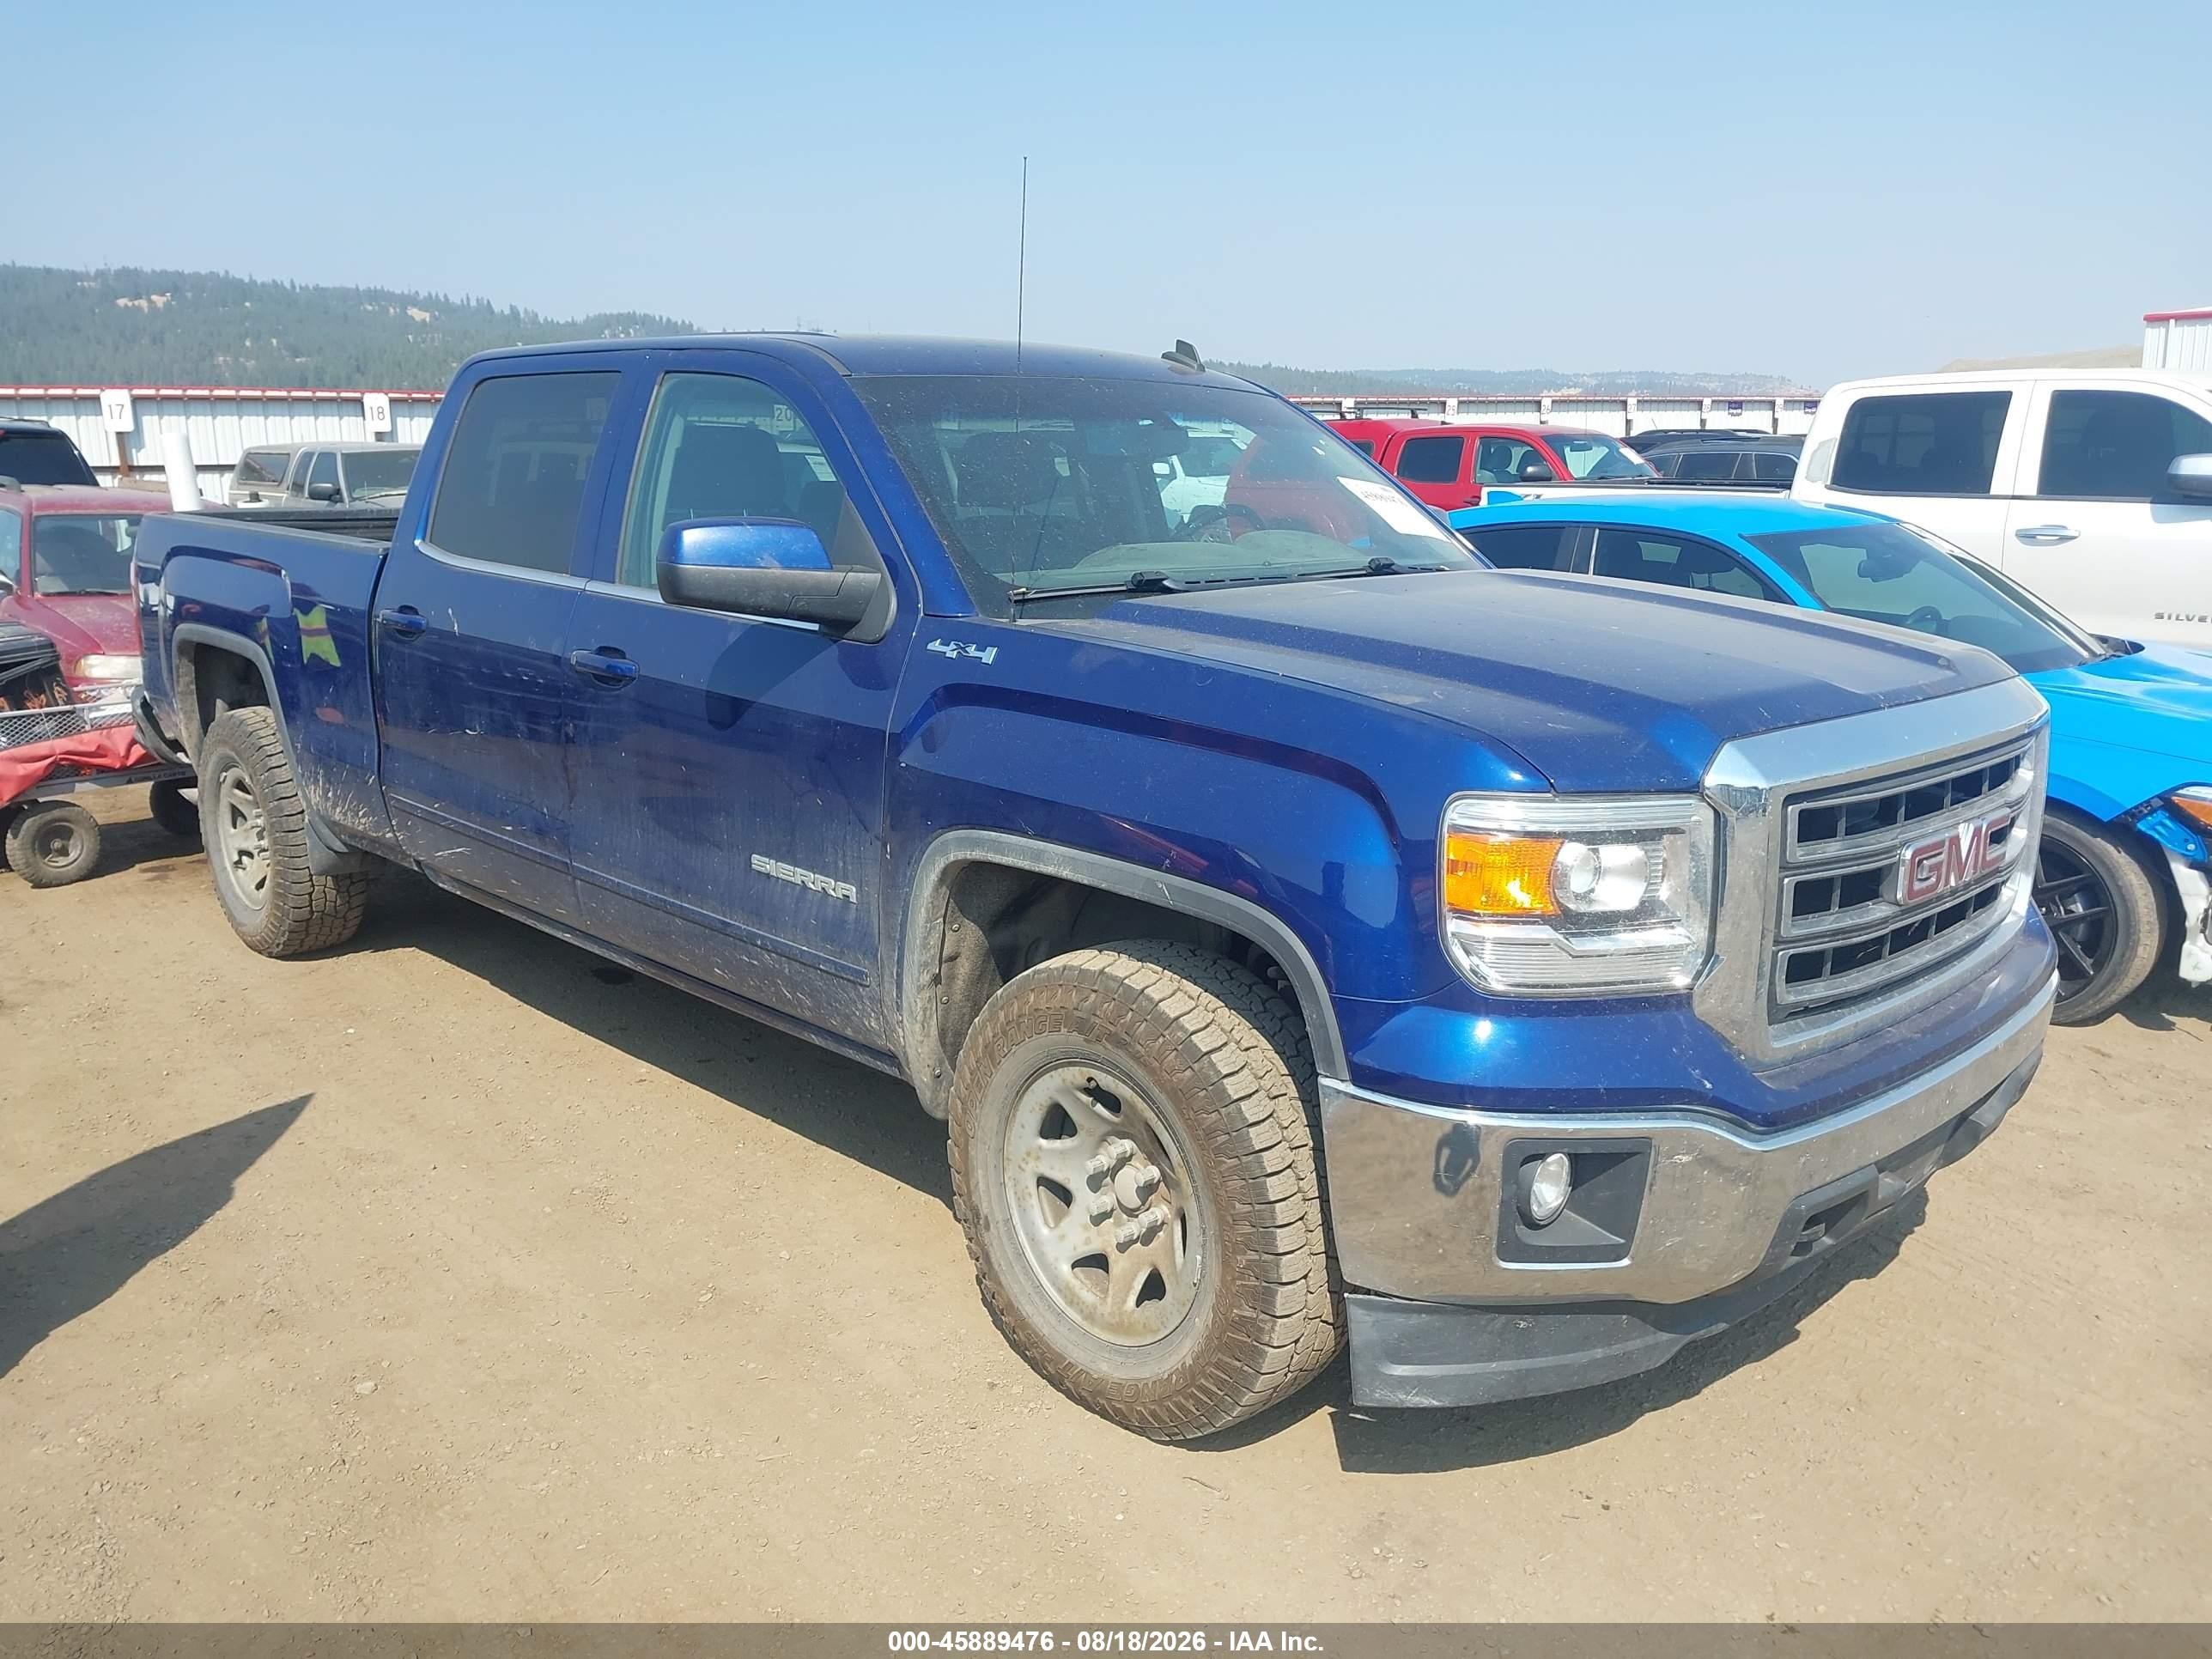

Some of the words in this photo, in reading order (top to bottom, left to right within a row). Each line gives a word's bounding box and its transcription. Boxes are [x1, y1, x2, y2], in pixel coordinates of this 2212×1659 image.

[108, 404, 125, 420] 17
[369, 405, 386, 421] 18
[775, 408, 793, 422] 20
[1541, 404, 1552, 415] 26
[1627, 404, 1637, 414] 27
[2154, 612, 2212, 623] SILVE
[1905, 814, 2012, 902] GMC
[750, 854, 858, 904] SIERRA
[993, 1013, 1065, 1066] RANGE
